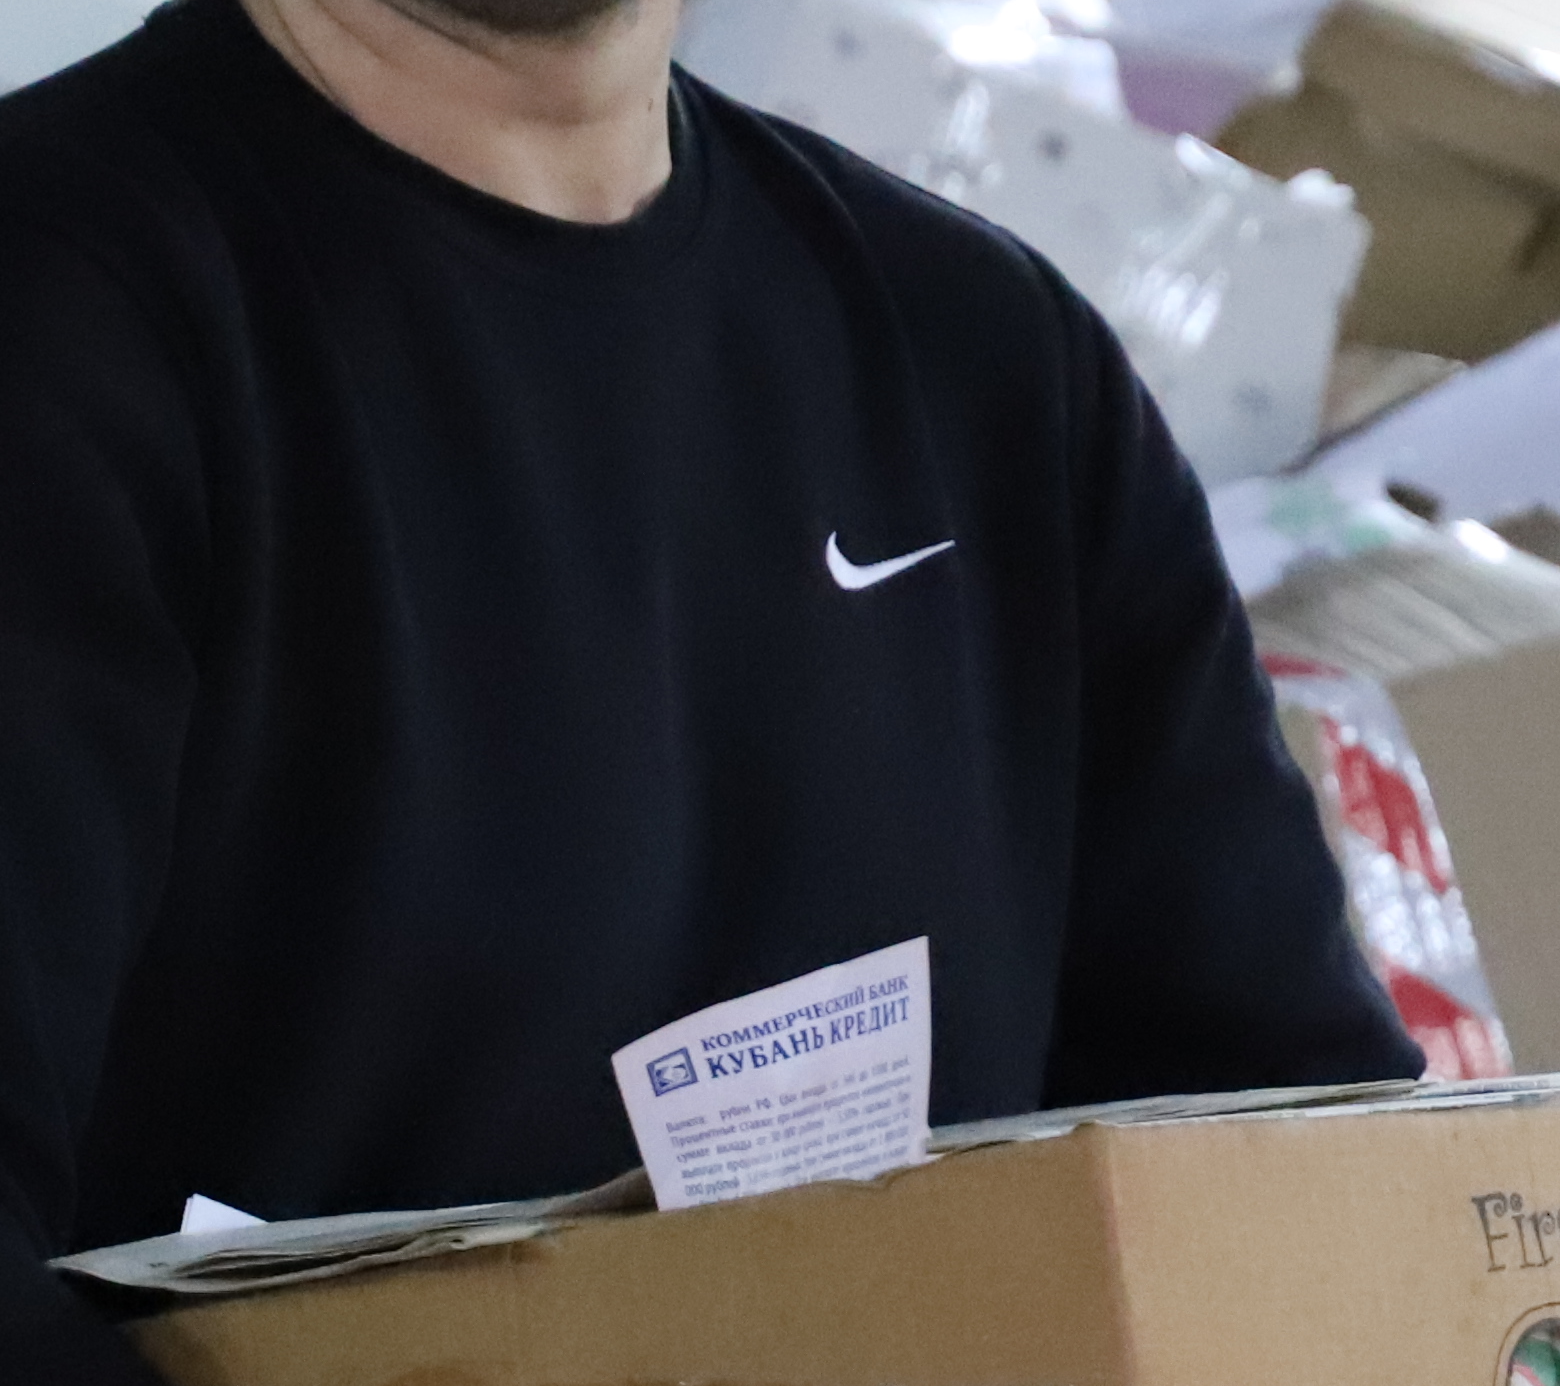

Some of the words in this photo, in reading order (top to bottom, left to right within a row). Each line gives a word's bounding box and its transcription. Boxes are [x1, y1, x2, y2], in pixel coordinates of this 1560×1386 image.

[701, 985, 866, 1052] КОММЕРЧЕСКИЙ
[869, 973, 910, 1004] БАНК
[706, 1026, 825, 1079] КУБАНЬ
[829, 996, 911, 1046] КРЕДИТ
